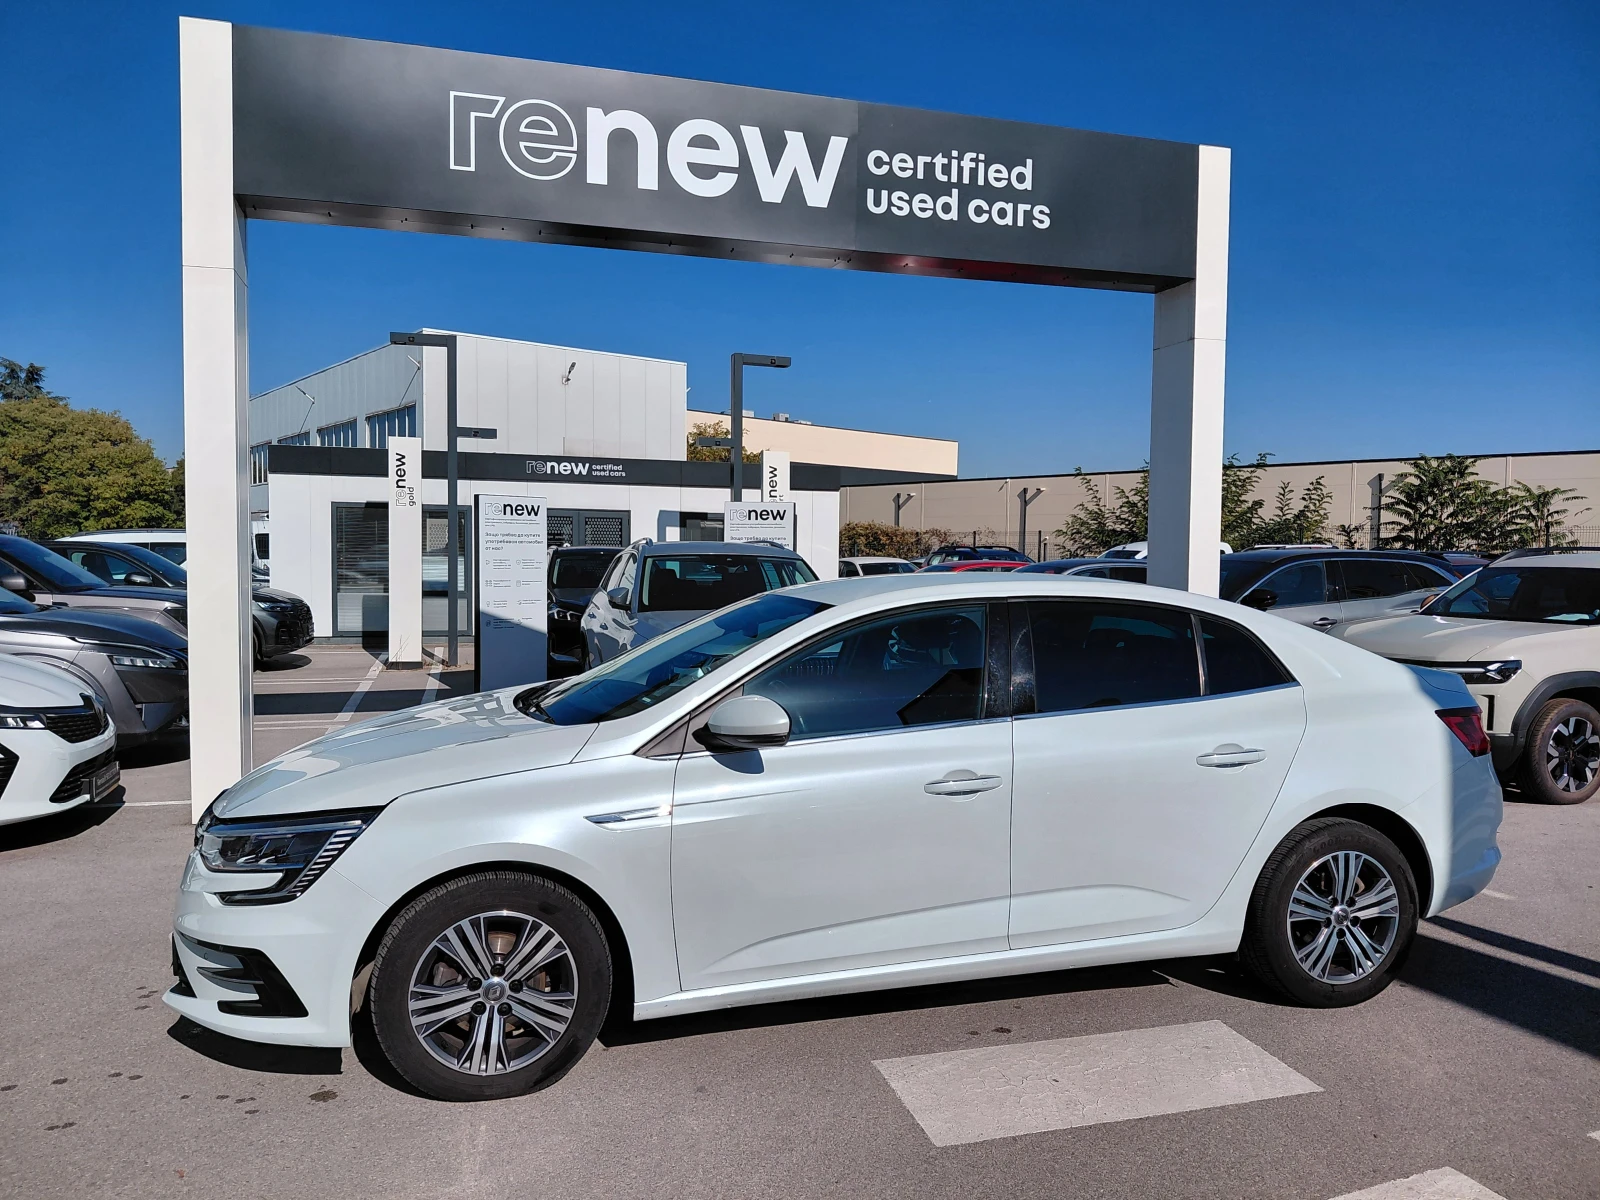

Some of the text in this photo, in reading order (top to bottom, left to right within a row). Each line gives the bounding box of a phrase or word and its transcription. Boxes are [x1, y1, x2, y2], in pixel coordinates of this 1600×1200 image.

[449, 90, 849, 208] renew
[866, 148, 1034, 191] certified
[866, 189, 1051, 229] used cars
[526, 460, 589, 475] renew
[592, 463, 623, 471] certified
[395, 452, 407, 507] renew
[407, 486, 416, 507] gold
[484, 502, 541, 517] renew
[729, 508, 787, 521] renew
